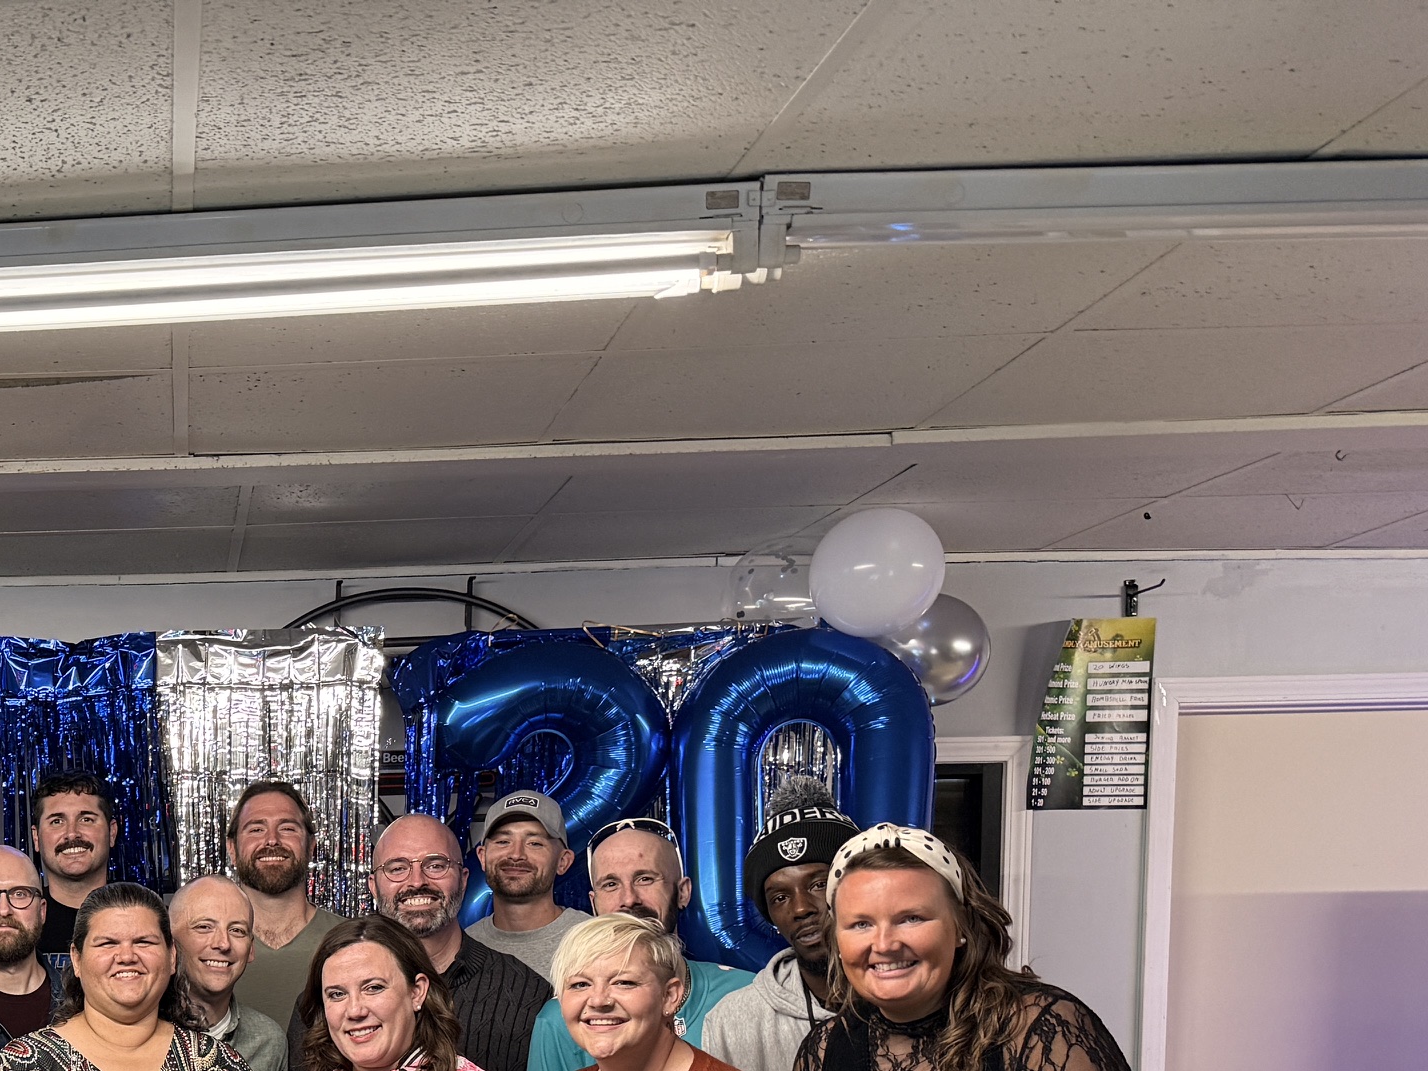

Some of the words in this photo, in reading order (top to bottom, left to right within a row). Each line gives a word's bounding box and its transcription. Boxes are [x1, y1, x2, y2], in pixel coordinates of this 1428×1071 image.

[1083, 639, 1141, 648] AMUSEMENT
[1064, 680, 1079, 688] Prize
[1092, 679, 1119, 687] HUNGRY
[1058, 695, 1074, 704] Prize
[1060, 711, 1076, 720] Prize
[1047, 735, 1057, 743] and
[1057, 736, 1072, 744] more
[1046, 745, 1056, 754] 500
[382, 752, 405, 764] Bee
[1046, 756, 1055, 765] 300
[1045, 767, 1055, 775] 200
[1032, 777, 1039, 786] 51
[1041, 777, 1052, 786] 100
[1031, 787, 1038, 796] 21
[1041, 787, 1048, 796] 50
[508, 797, 536, 806] RVCA
[1031, 798, 1035, 807] 1
[1037, 798, 1044, 807] 20
